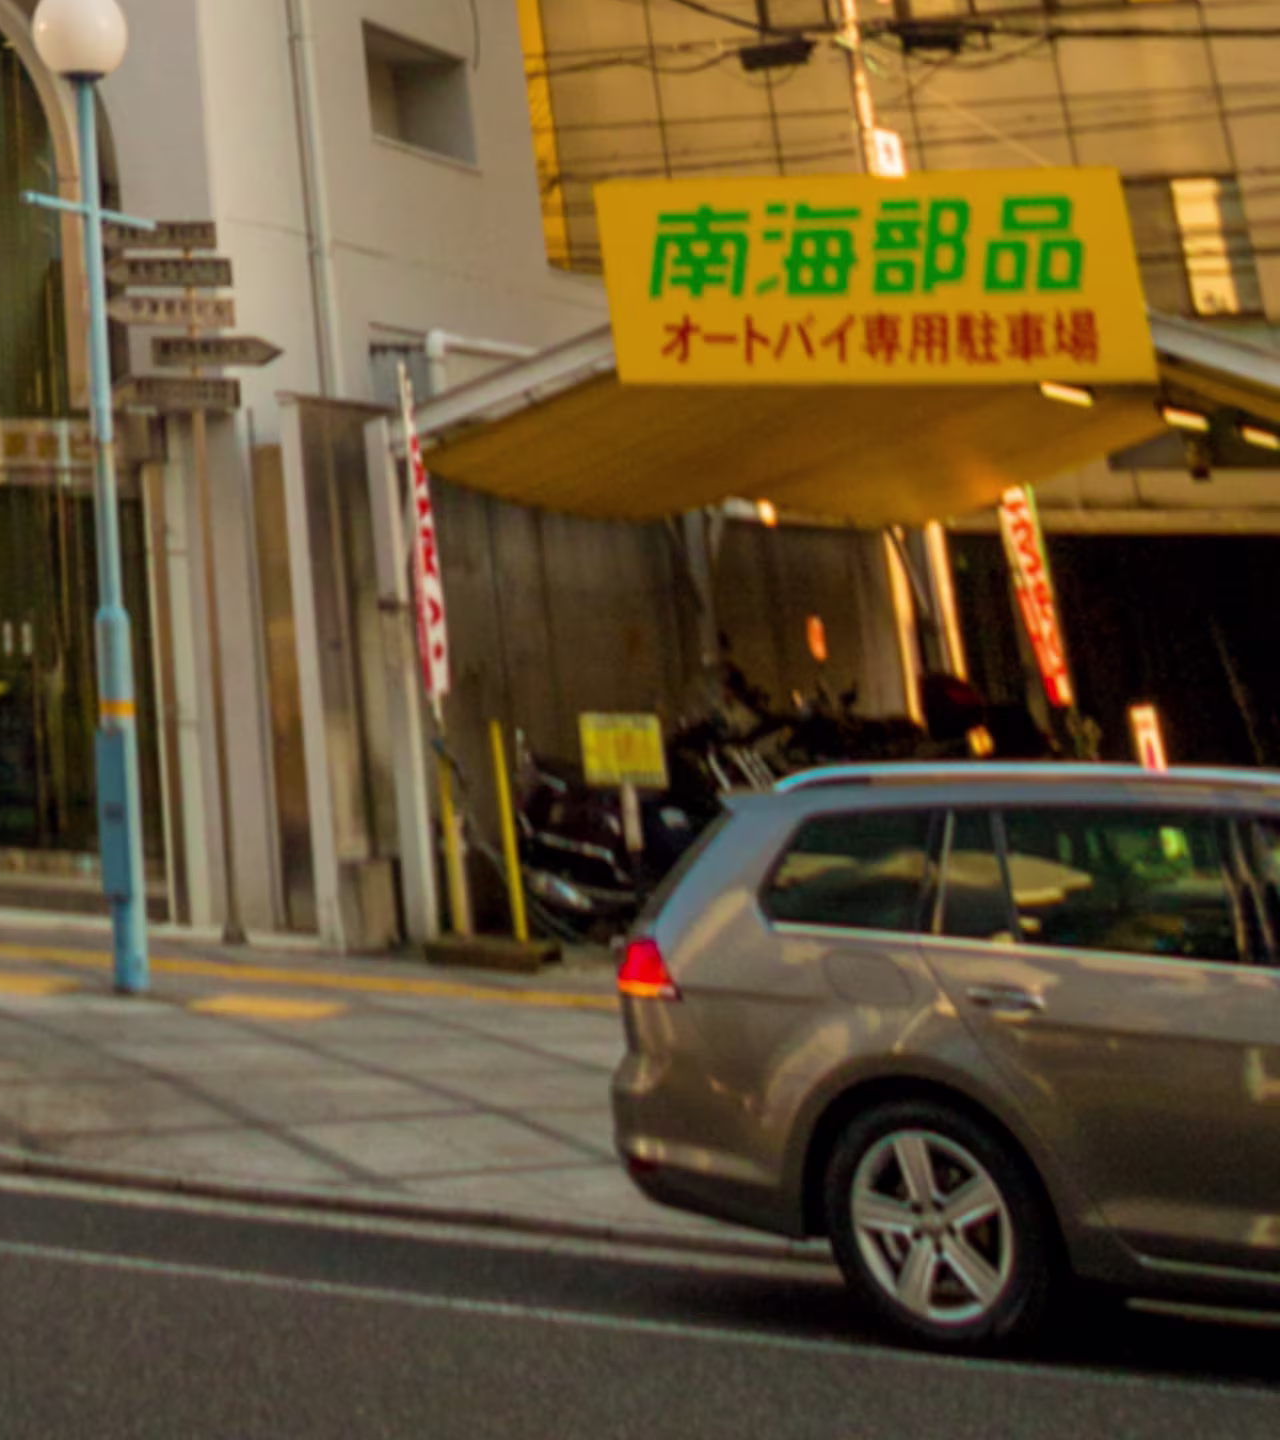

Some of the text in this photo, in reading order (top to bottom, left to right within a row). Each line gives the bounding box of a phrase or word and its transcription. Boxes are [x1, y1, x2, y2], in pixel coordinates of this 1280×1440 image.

[649, 195, 1084, 299] 南海部品
[661, 309, 1101, 366] オートバイ専用駐車場
